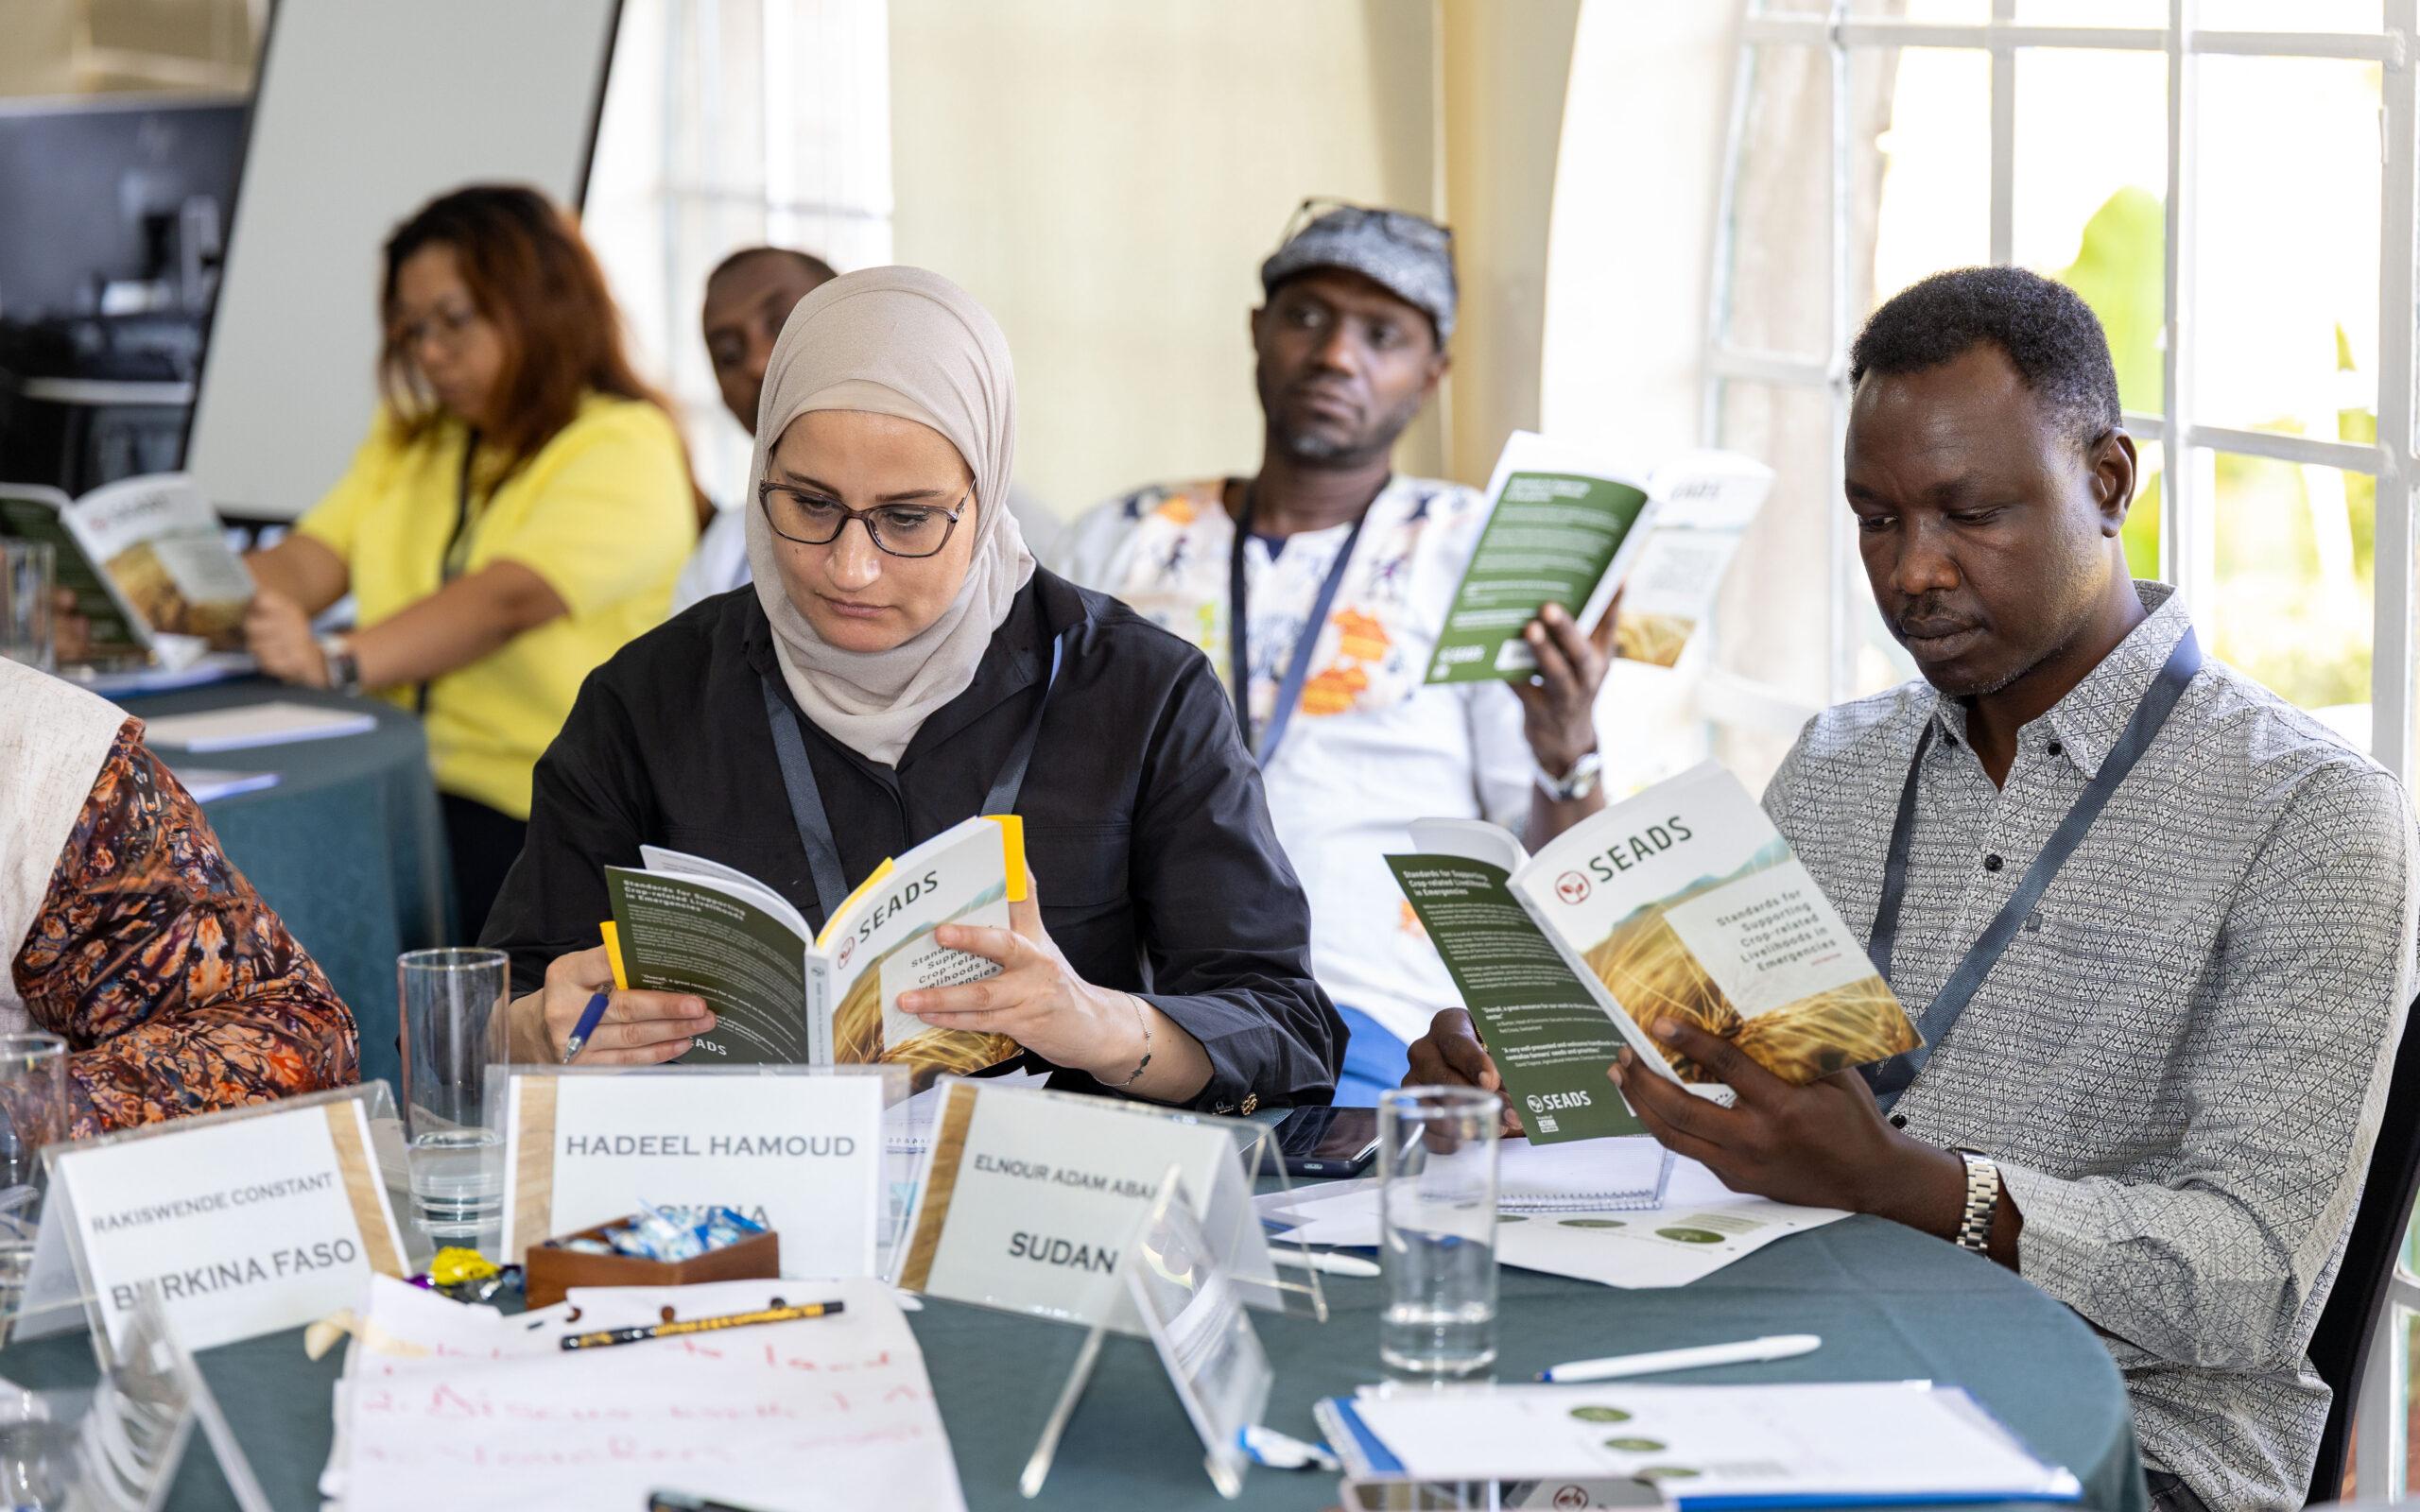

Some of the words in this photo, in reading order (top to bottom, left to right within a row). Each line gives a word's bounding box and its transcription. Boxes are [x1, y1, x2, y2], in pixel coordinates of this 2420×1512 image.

[1589, 816, 1692, 883] SEADS
[623, 879, 674, 894] Standards
[676, 888, 691, 897] for
[693, 892, 746, 917] Supporting
[624, 885, 687, 903] Crop-related
[638, 894, 701, 913] Emergencies
[859, 870, 938, 943] SEADS
[1716, 898, 1780, 927] Standards
[1782, 890, 1801, 902] for
[1740, 902, 1811, 932] Supporting
[1740, 913, 1820, 948] Crop-related
[1740, 931, 1812, 963] Livelihoods
[1814, 926, 1828, 936] in
[1756, 938, 1837, 971] Emergencies
[1542, 1091, 1592, 1110] SEADS
[566, 1135, 700, 1158] HADEEL
[709, 1135, 856, 1158] HAMOUD
[974, 1153, 1049, 1181] ELNOUR
[1052, 1168, 1108, 1191] ADAM
[92, 1191, 229, 1234] RAKISWENDE
[232, 1171, 334, 1207] CONSTANT
[1008, 1230, 1119, 1276] SUDAN
[110, 1256, 268, 1312] BRKINA
[271, 1239, 357, 1278] FASO
